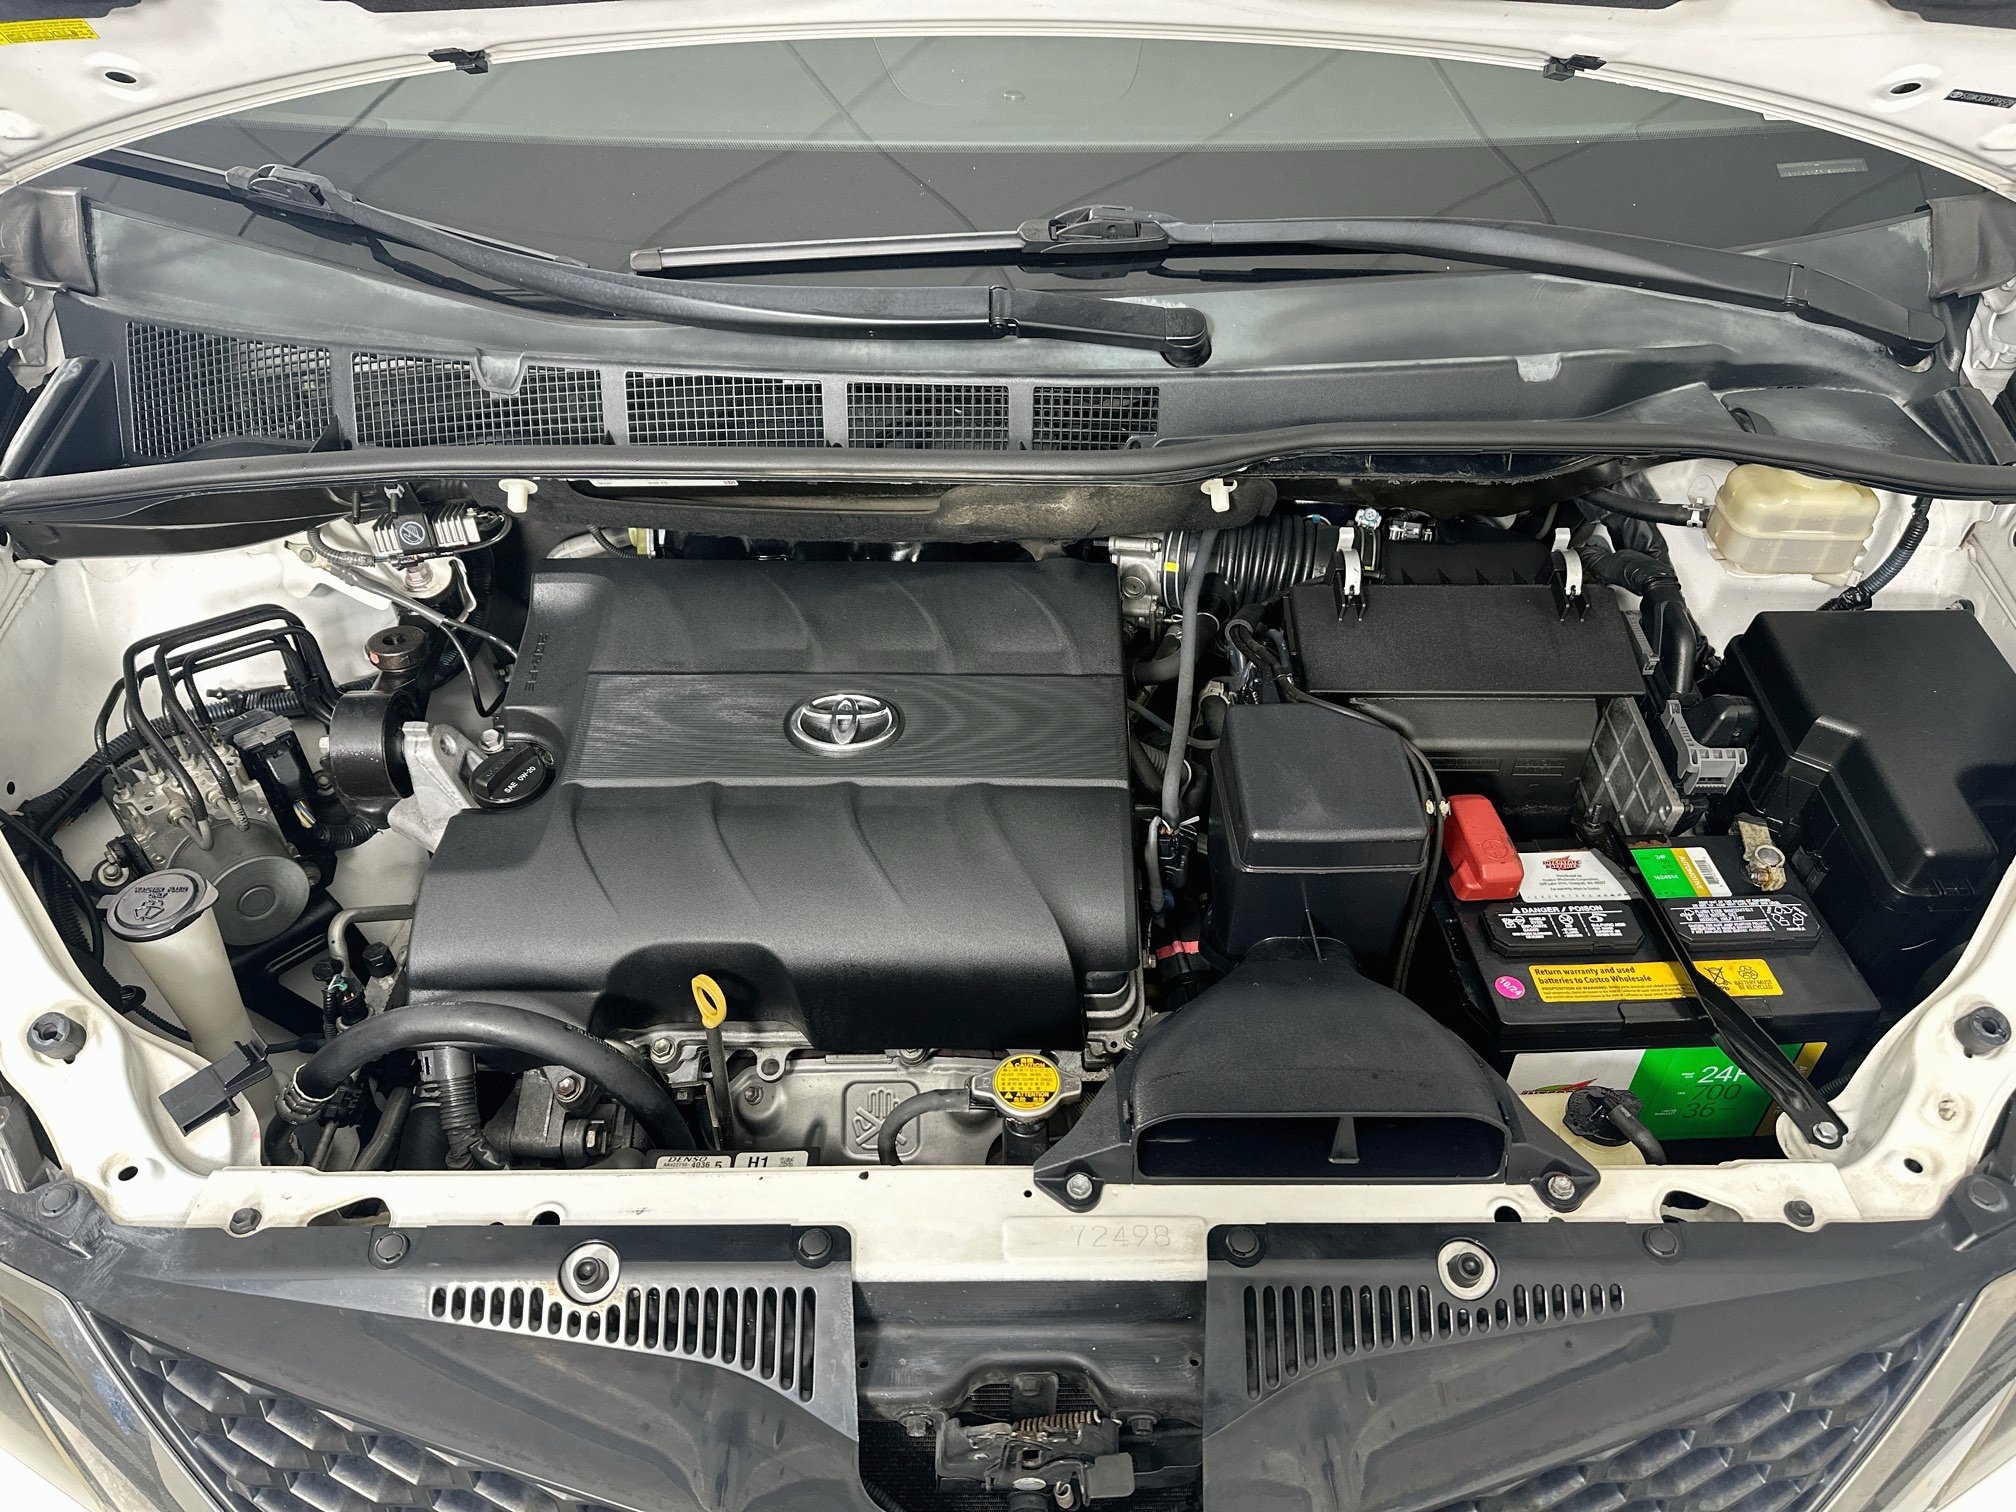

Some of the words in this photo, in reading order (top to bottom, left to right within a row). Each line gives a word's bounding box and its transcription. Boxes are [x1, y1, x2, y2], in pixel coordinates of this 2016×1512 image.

[504, 781, 518, 794] SAE
[517, 766, 536, 781] 0W-20
[1679, 855, 1704, 890] AUTOMOTIVE
[1563, 968, 1598, 976] warranty
[1500, 978, 1522, 995] 10/24
[1692, 1084, 1742, 1100] 700
[1682, 1102, 1716, 1118] 36
[748, 1156, 768, 1168] H1
[1071, 1224, 1171, 1247] 72498
